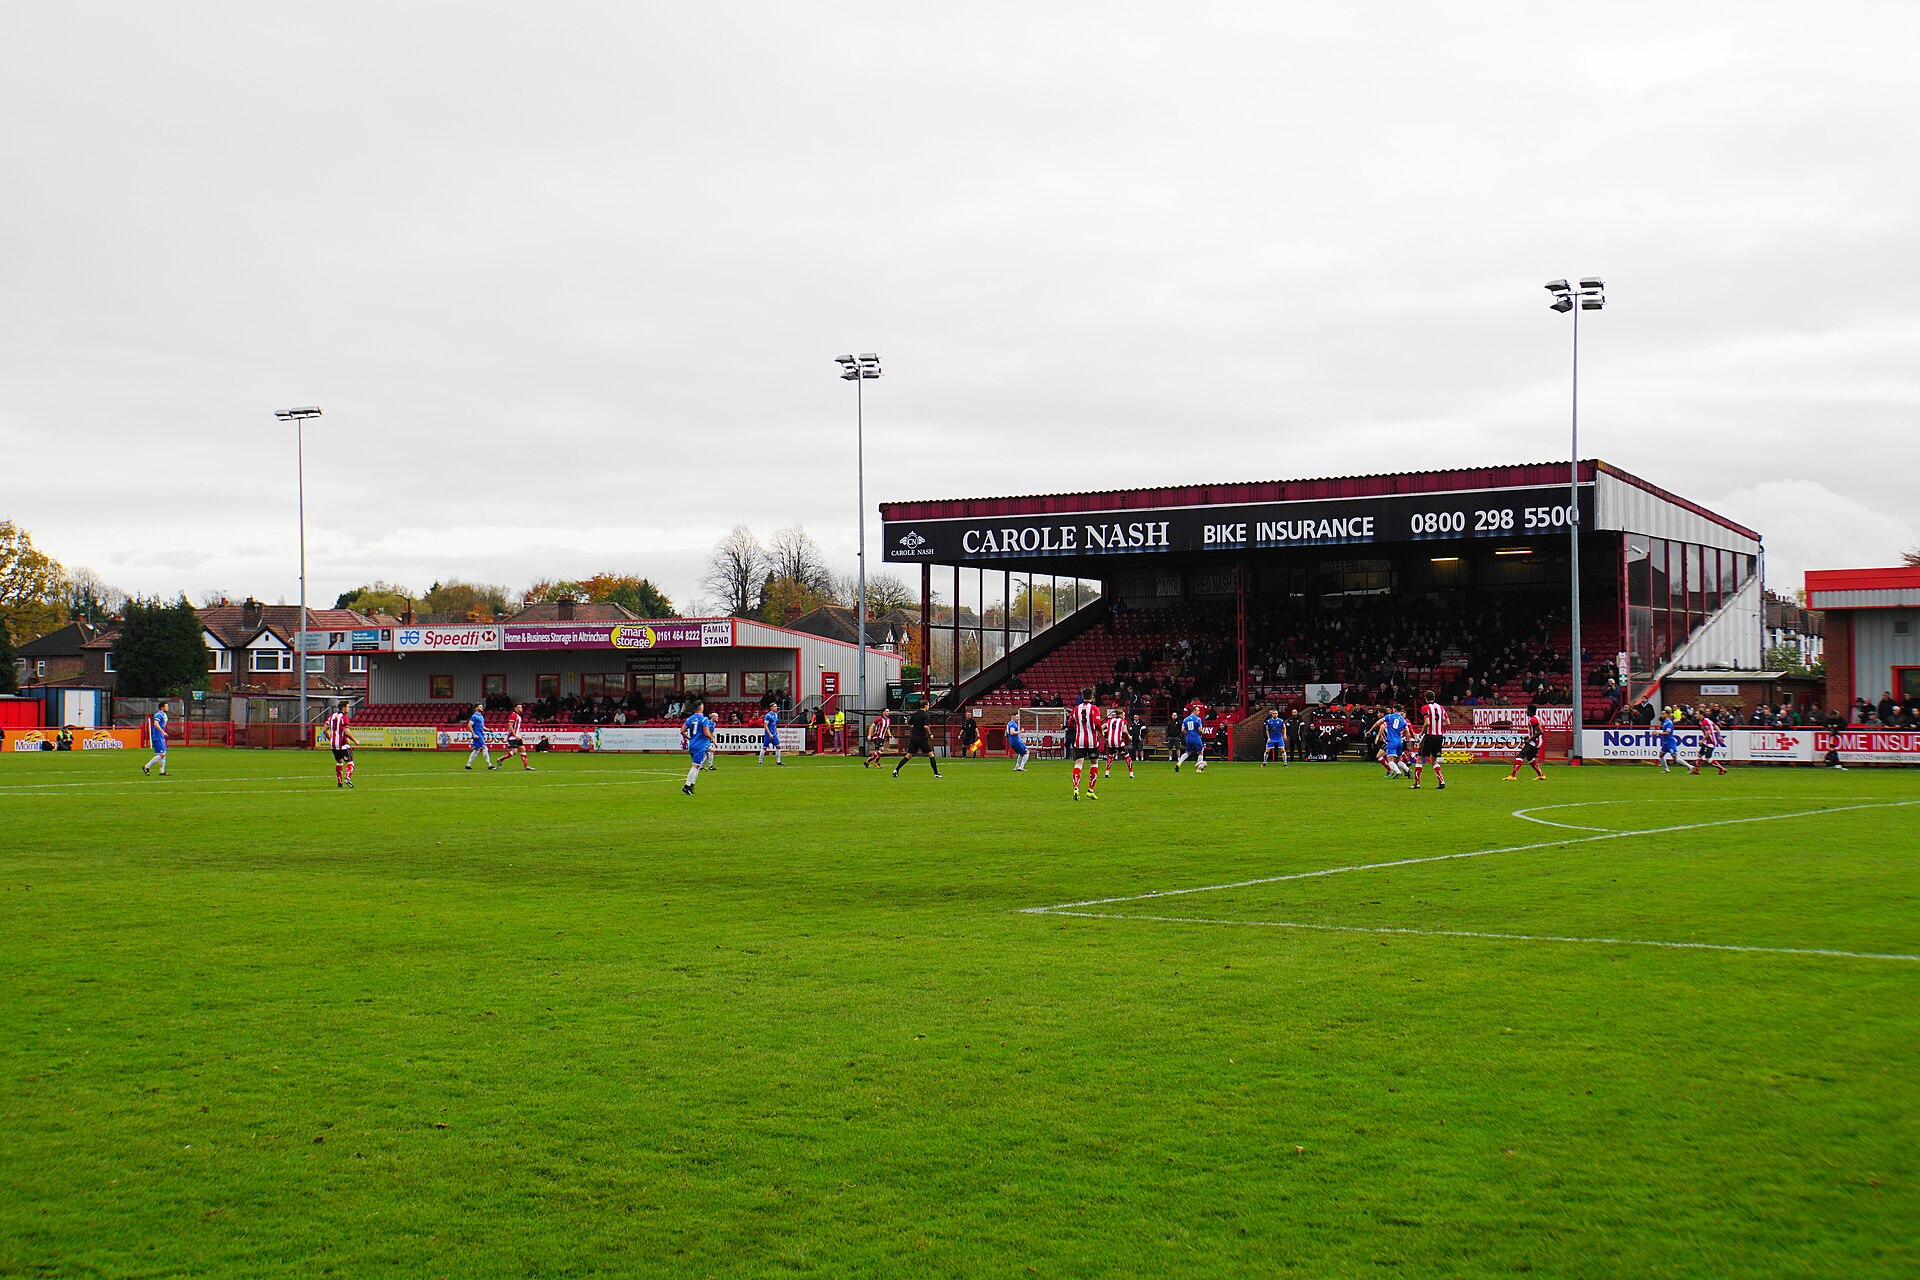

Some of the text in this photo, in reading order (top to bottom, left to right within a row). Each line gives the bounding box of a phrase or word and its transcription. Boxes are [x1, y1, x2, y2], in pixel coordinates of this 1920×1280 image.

[1411, 505, 1580, 534] 0800 298 5500
[1203, 517, 1374, 544] BIKE INSURANCE
[962, 521, 1170, 553] CAROLE NASH
[620, 627, 646, 637] smart
[703, 625, 729, 633] FAMILY
[424, 630, 479, 648] Speedfi
[505, 631, 609, 645] Home & Business Storage in Altrincham
[657, 631, 670, 641] 0161
[685, 630, 700, 640] 8222
[704, 636, 728, 644] STAND
[616, 637, 650, 648] storage
[1553, 709, 1573, 728] STAN
[692, 722, 698, 735] 7
[1187, 721, 1194, 730] 10
[84, 739, 122, 749] Mornflake
[712, 733, 764, 744] binson
[1818, 734, 1868, 750] HOME
